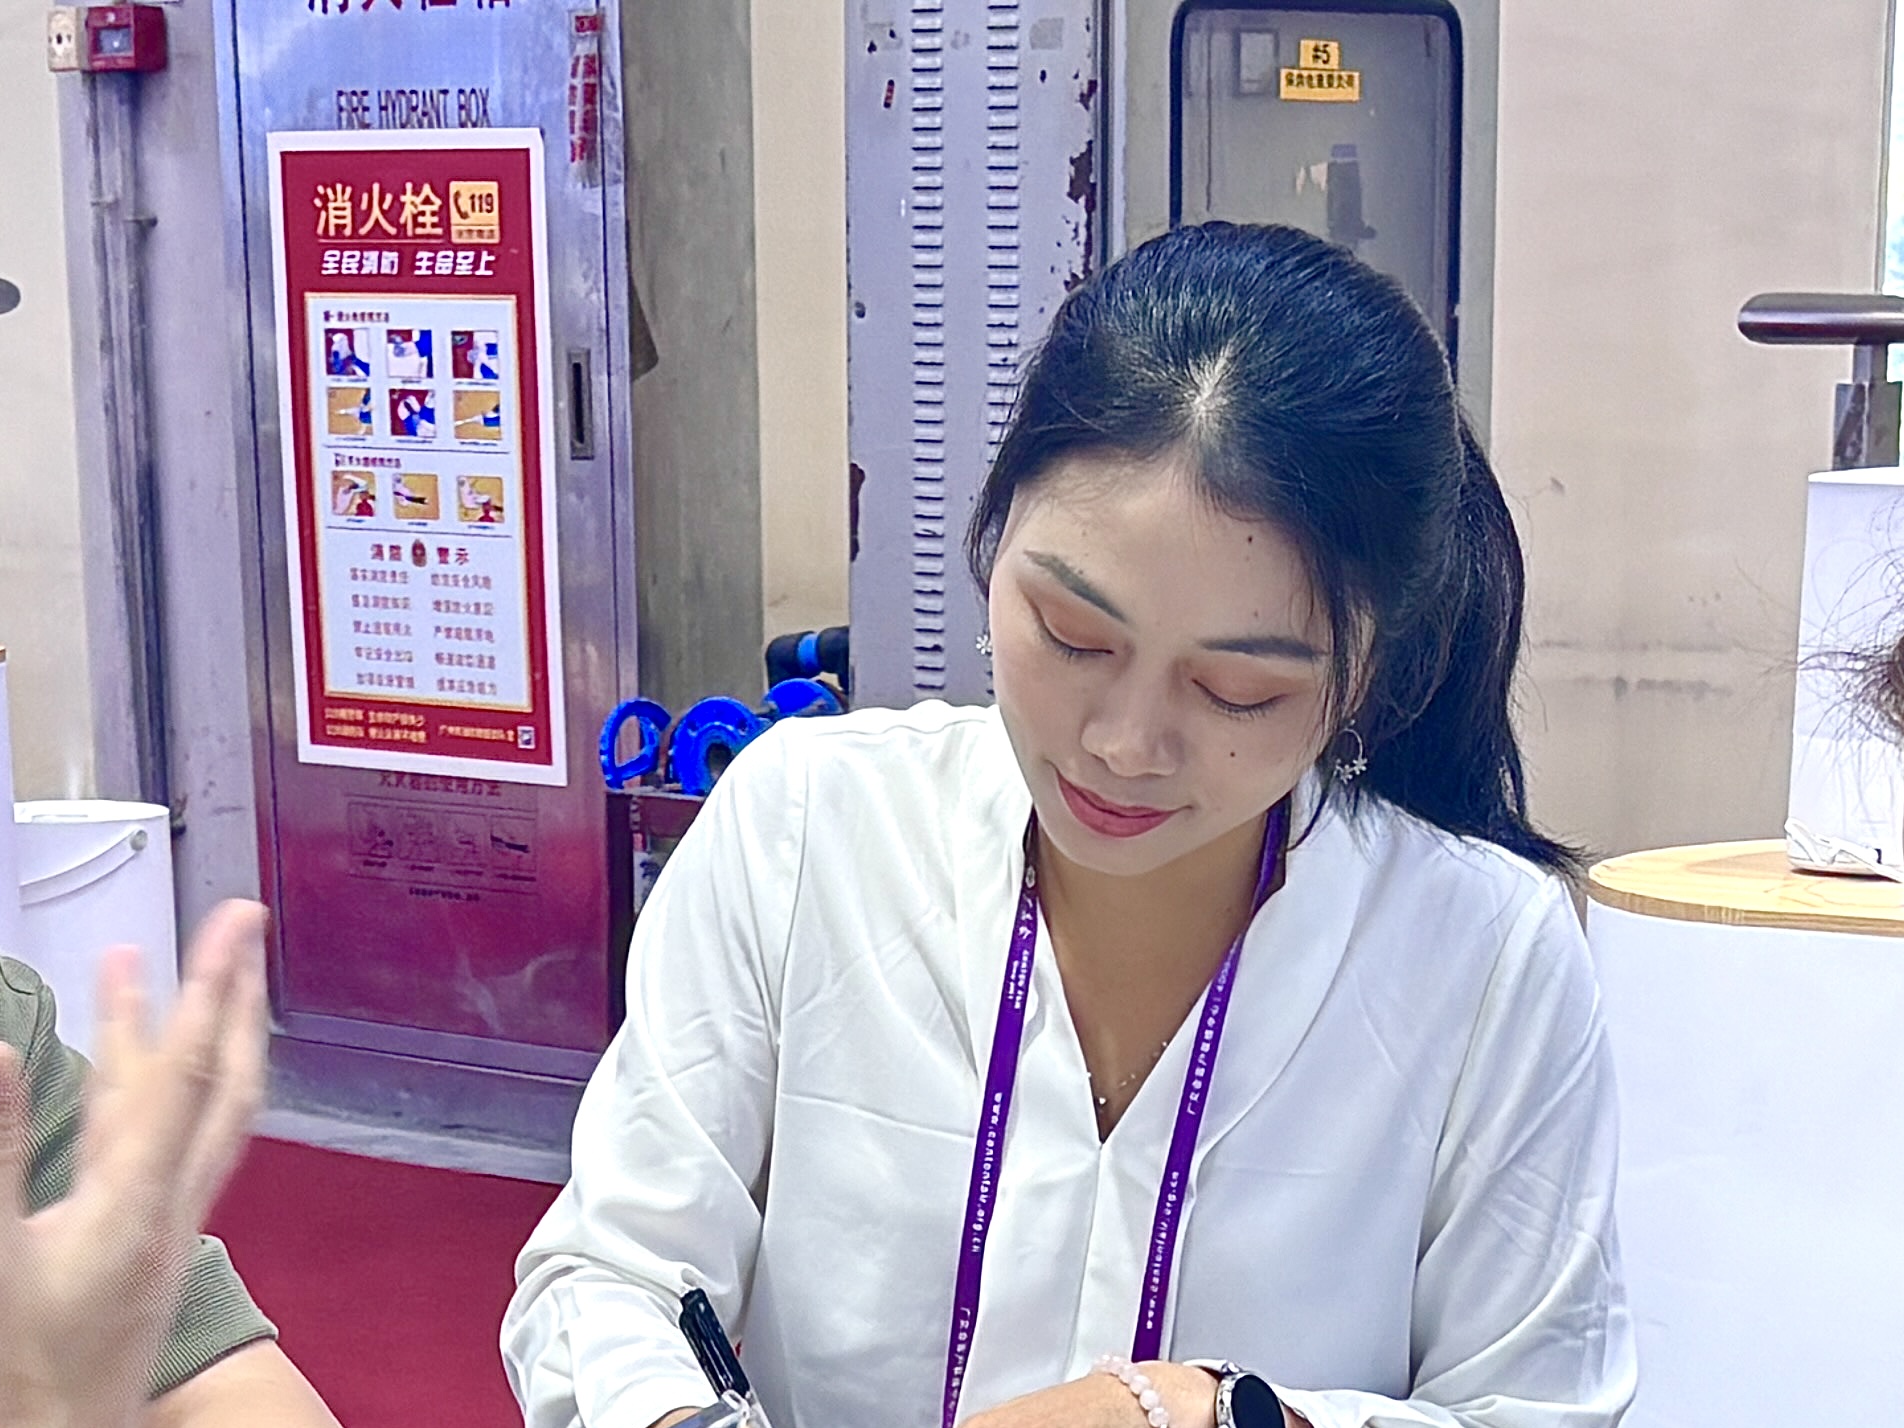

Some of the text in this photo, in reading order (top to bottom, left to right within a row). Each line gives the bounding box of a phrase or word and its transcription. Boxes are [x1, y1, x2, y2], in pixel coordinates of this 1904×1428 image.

[1312, 43, 1331, 65] #5
[336, 87, 491, 129] FIRE HYDRANT BOX
[313, 182, 444, 237] 消火栓
[469, 192, 494, 214] 119
[321, 250, 496, 276] 全民消防 生命至上
